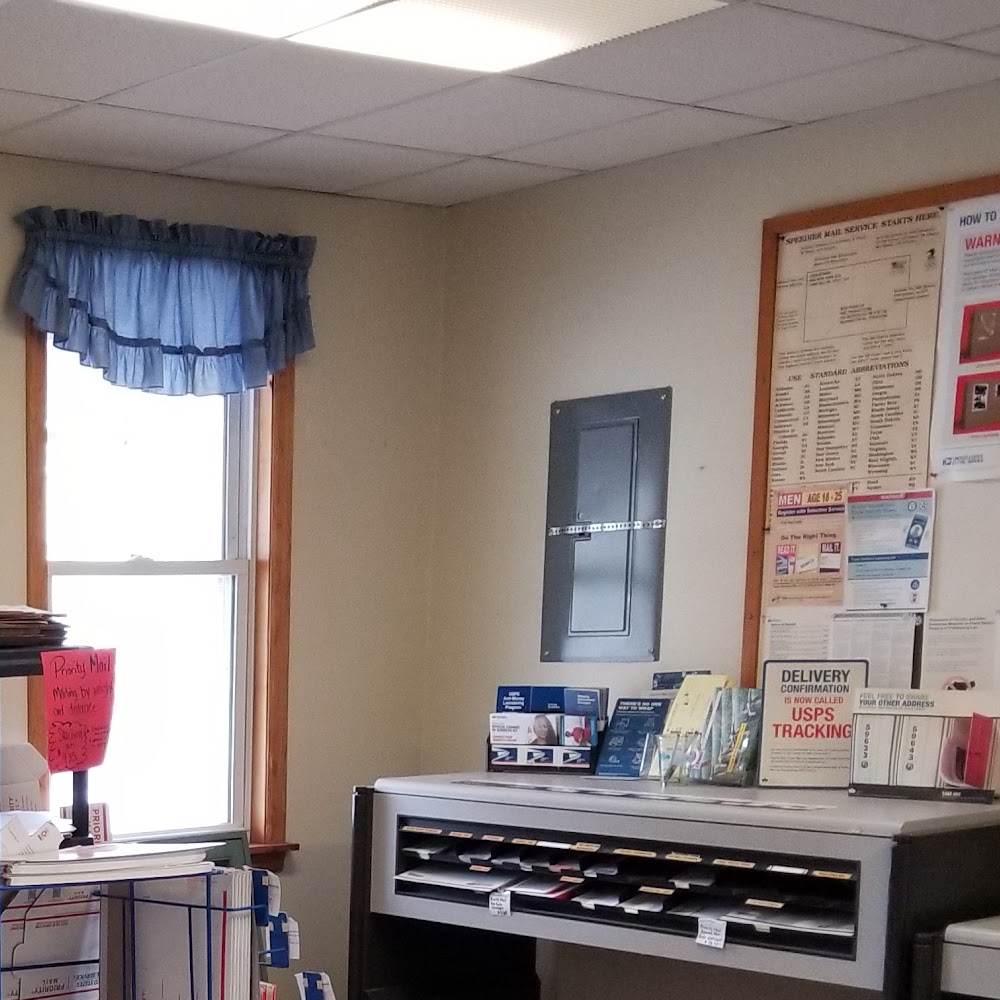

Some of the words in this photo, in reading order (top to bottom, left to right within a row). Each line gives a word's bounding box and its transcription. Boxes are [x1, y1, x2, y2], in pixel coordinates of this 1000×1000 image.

[960, 213, 981, 227] HOW
[985, 210, 997, 222] TO
[823, 229, 843, 239] MAIL
[844, 222, 878, 235] SERVICE
[881, 216, 913, 228] STARTS
[810, 368, 848, 379] STANDARD
[851, 360, 910, 375] ABBREVIATIONS
[778, 493, 802, 506] MEN
[807, 493, 821, 503] AGE
[834, 490, 843, 501] 25
[50, 655, 86, 679] Priority
[89, 653, 111, 672] Mail
[781, 669, 851, 683] DELIVERY
[80, 685, 90, 699] by
[780, 684, 850, 693] CONFIRMATION
[794, 696, 812, 704] NOW
[814, 696, 844, 704] CALLED
[878, 699, 901, 707] OTHER
[896, 692, 905, 700] TO
[791, 706, 835, 722] USPS
[772, 723, 852, 739] TRACKING
[31, 983, 65, 995] PRIORITY
[41, 978, 58, 986] MAIL
